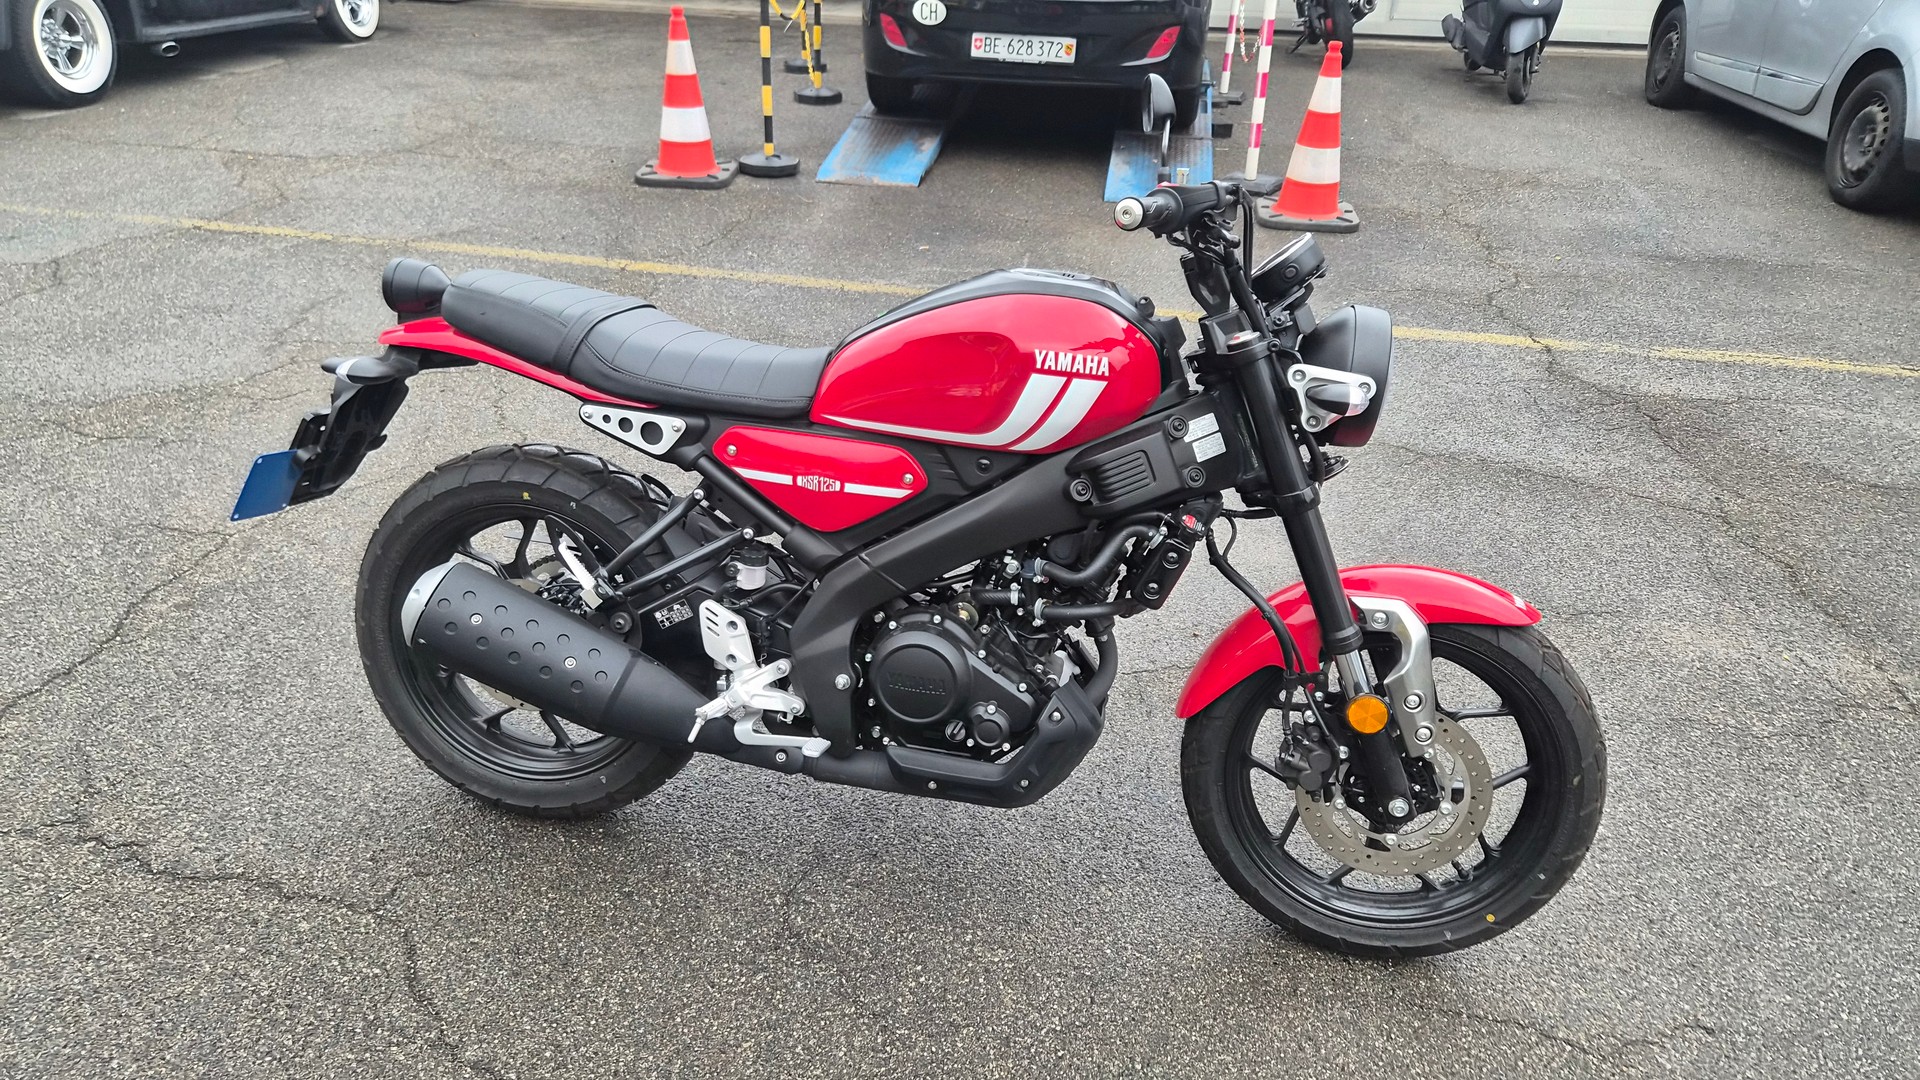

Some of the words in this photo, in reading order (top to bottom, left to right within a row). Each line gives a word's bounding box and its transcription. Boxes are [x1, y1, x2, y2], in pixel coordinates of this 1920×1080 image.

[920, 3, 938, 21] CH
[1034, 349, 1109, 377] YAMAHA
[802, 475, 835, 492] XSR125
